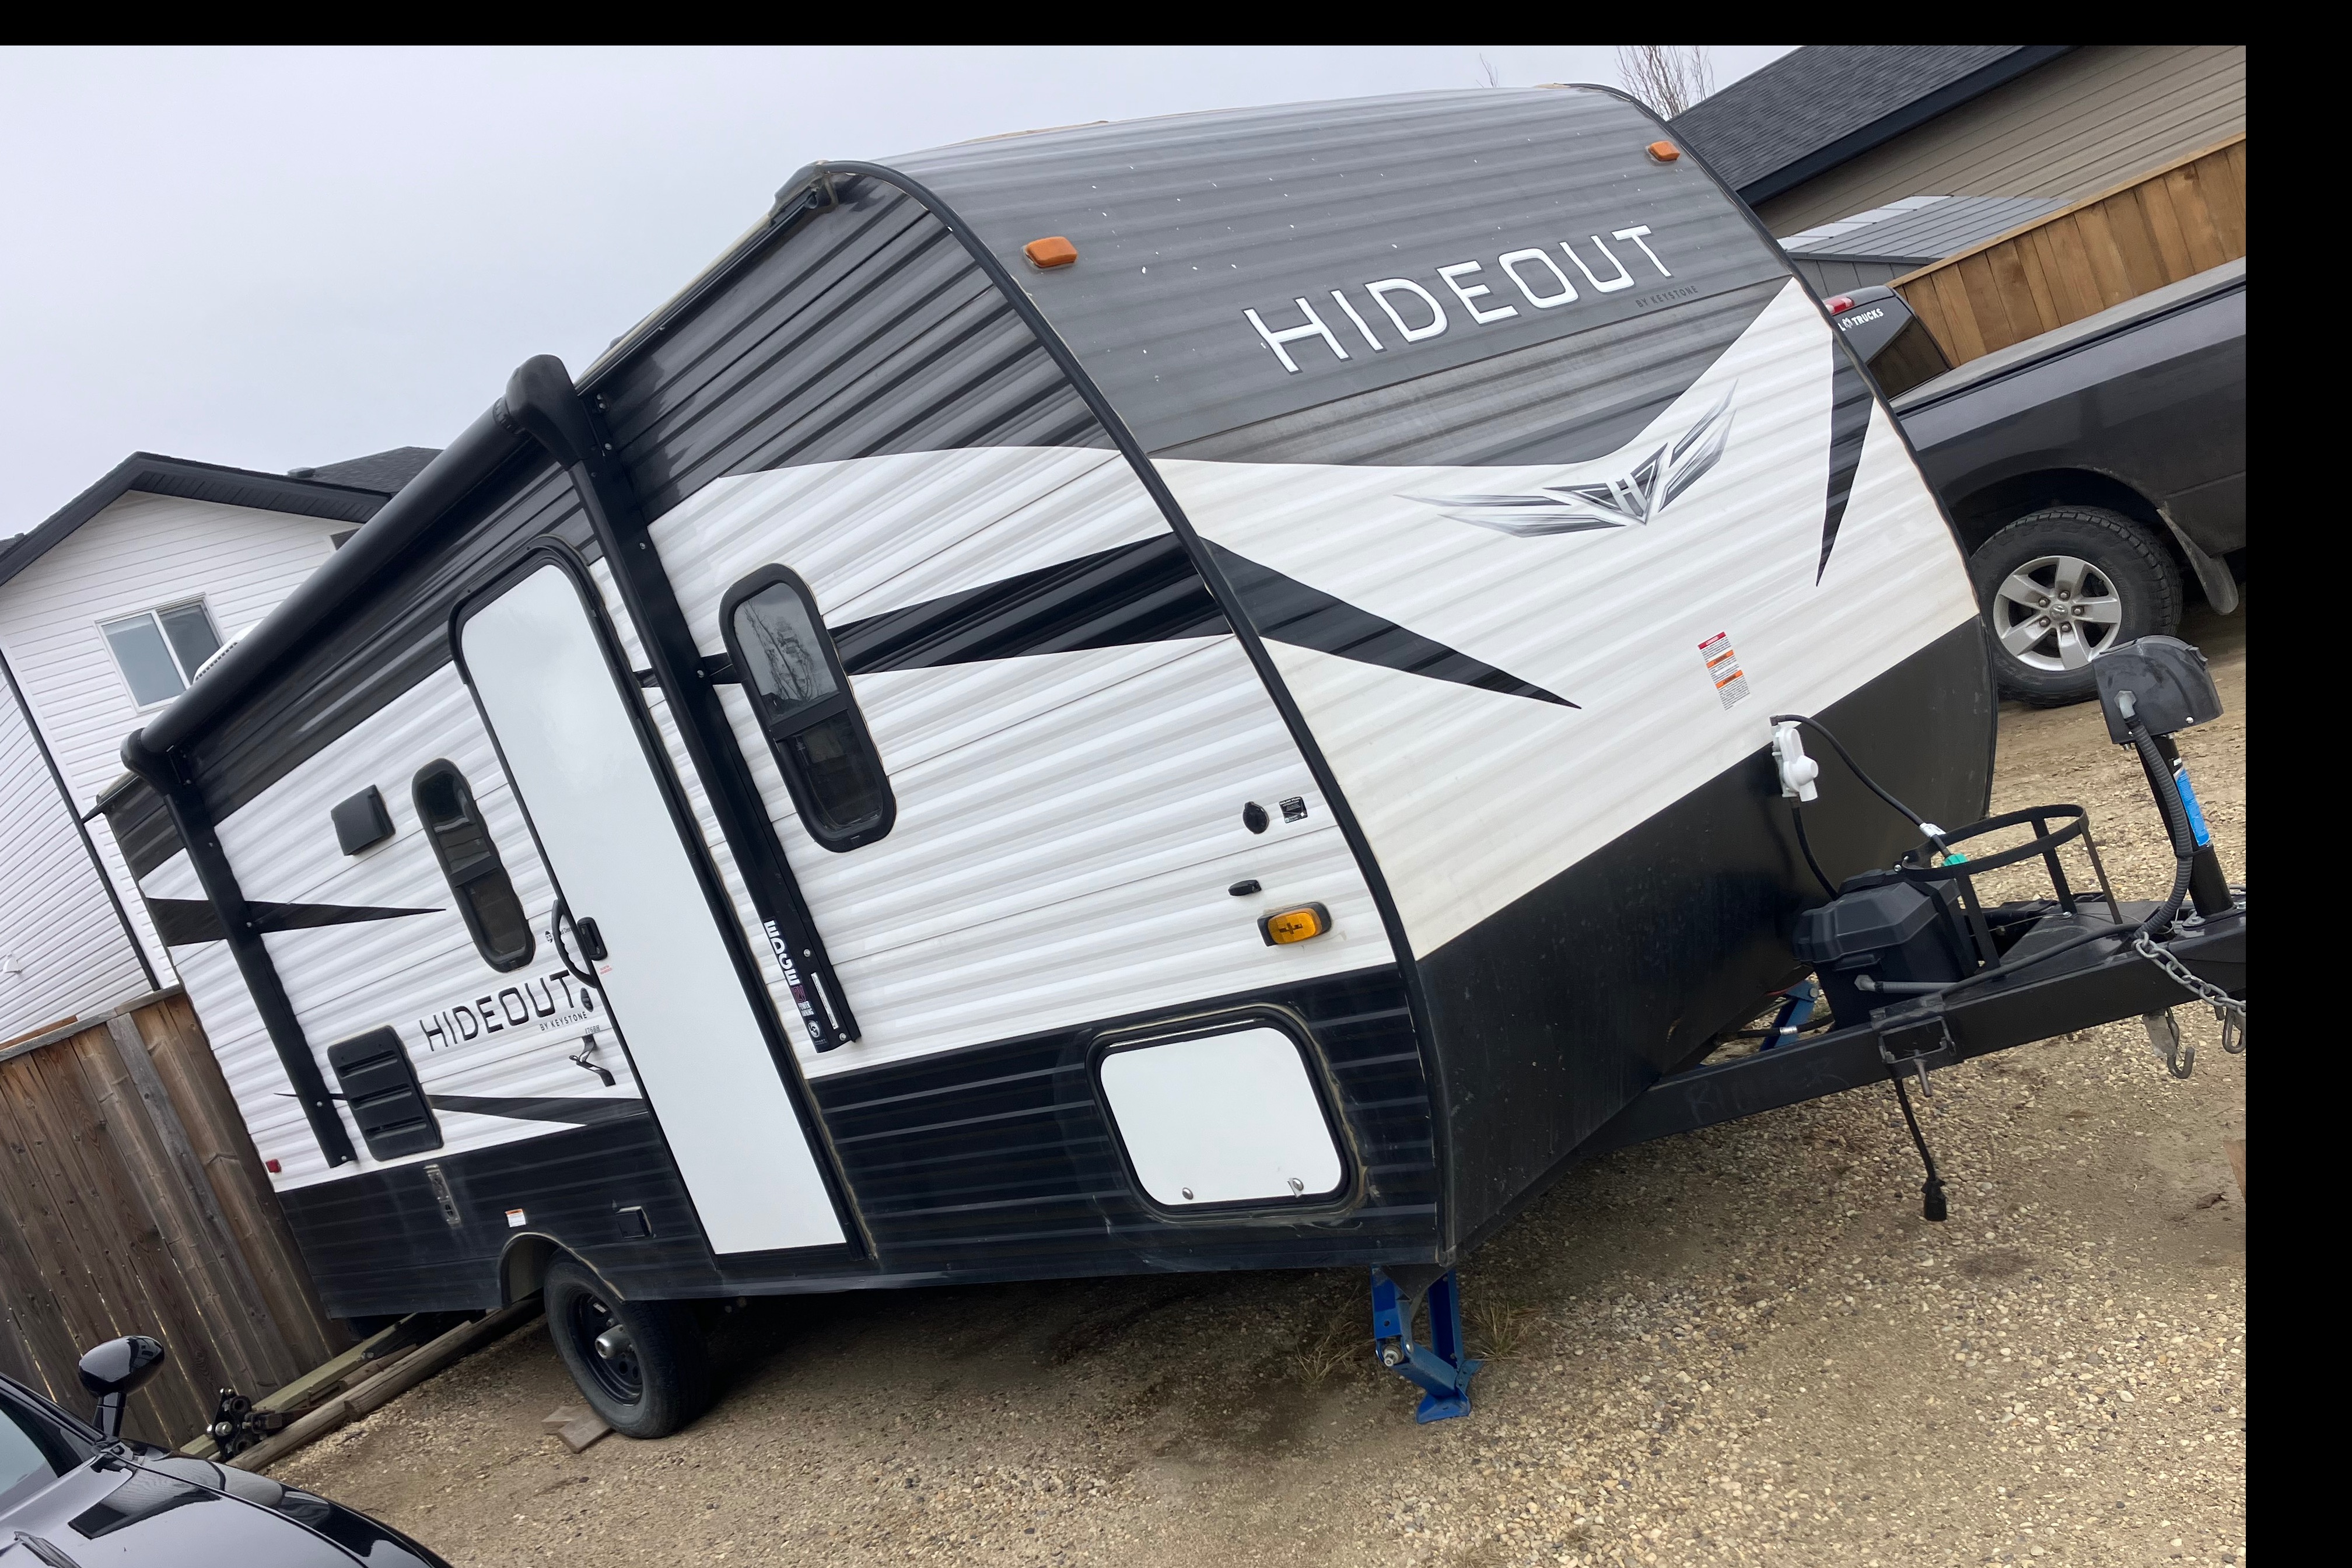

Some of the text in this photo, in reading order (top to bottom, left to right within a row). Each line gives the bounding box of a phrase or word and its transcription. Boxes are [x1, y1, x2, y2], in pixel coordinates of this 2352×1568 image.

[1243, 224, 1674, 374] HIDEOUT
[1635, 285, 1698, 308] BY KEYSTONE
[1851, 308, 1884, 326] TRUCKS
[764, 920, 800, 985] EDGE
[419, 969, 575, 1052] HIDEOUT
[540, 1011, 587, 1031] BY KEYSTONE
